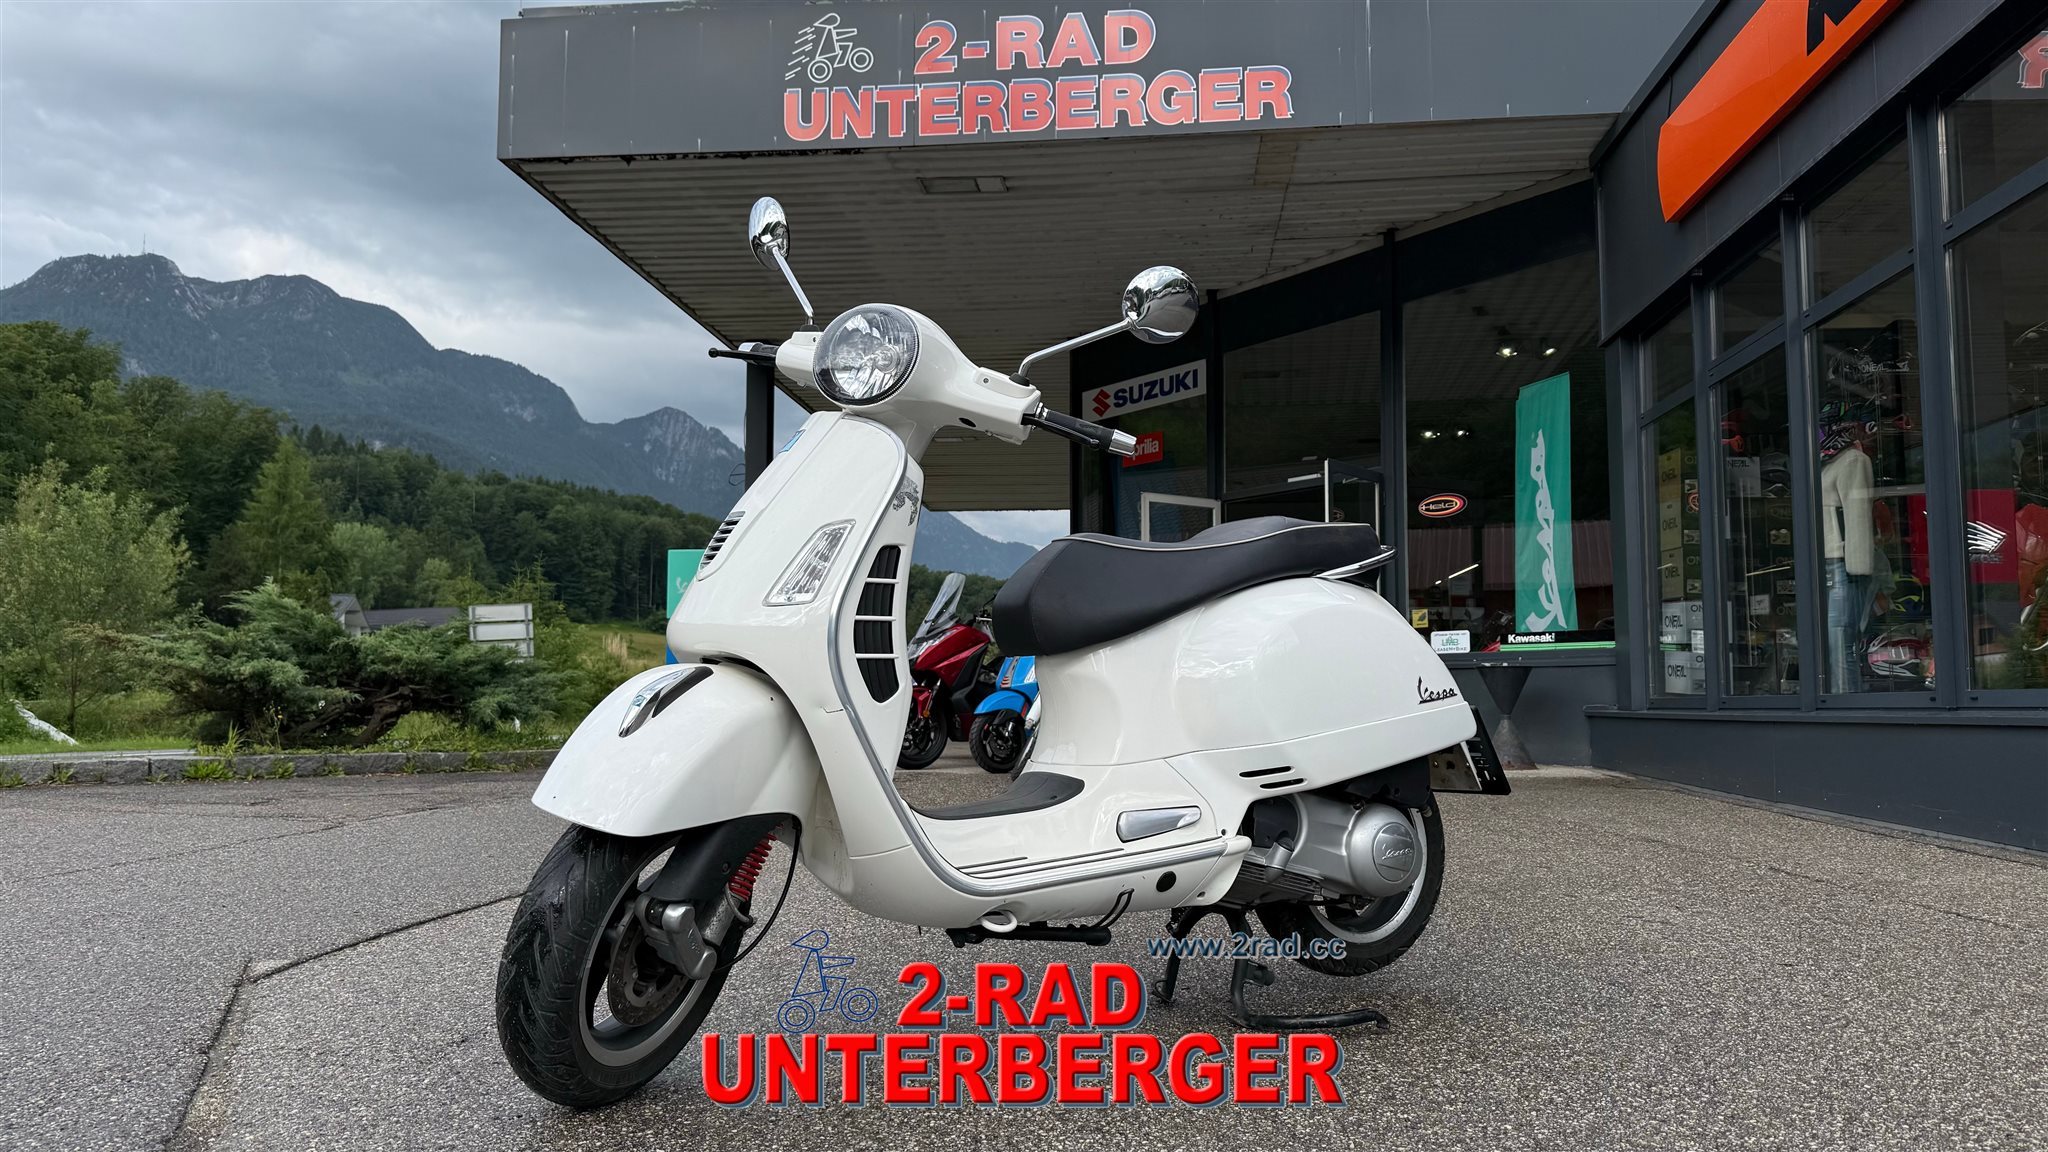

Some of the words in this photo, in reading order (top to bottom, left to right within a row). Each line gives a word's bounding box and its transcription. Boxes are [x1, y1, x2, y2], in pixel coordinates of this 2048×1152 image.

[915, 9, 1156, 75] 2-RAD
[784, 65, 1294, 141] UNTERBERGER
[1113, 368, 1199, 409] SUZUKI
[1132, 438, 1160, 460] prilia
[1421, 501, 1456, 511] Held
[1524, 428, 1568, 632] Vespa
[1507, 632, 1556, 644] Kawasaki
[1417, 676, 1458, 705] Vespa
